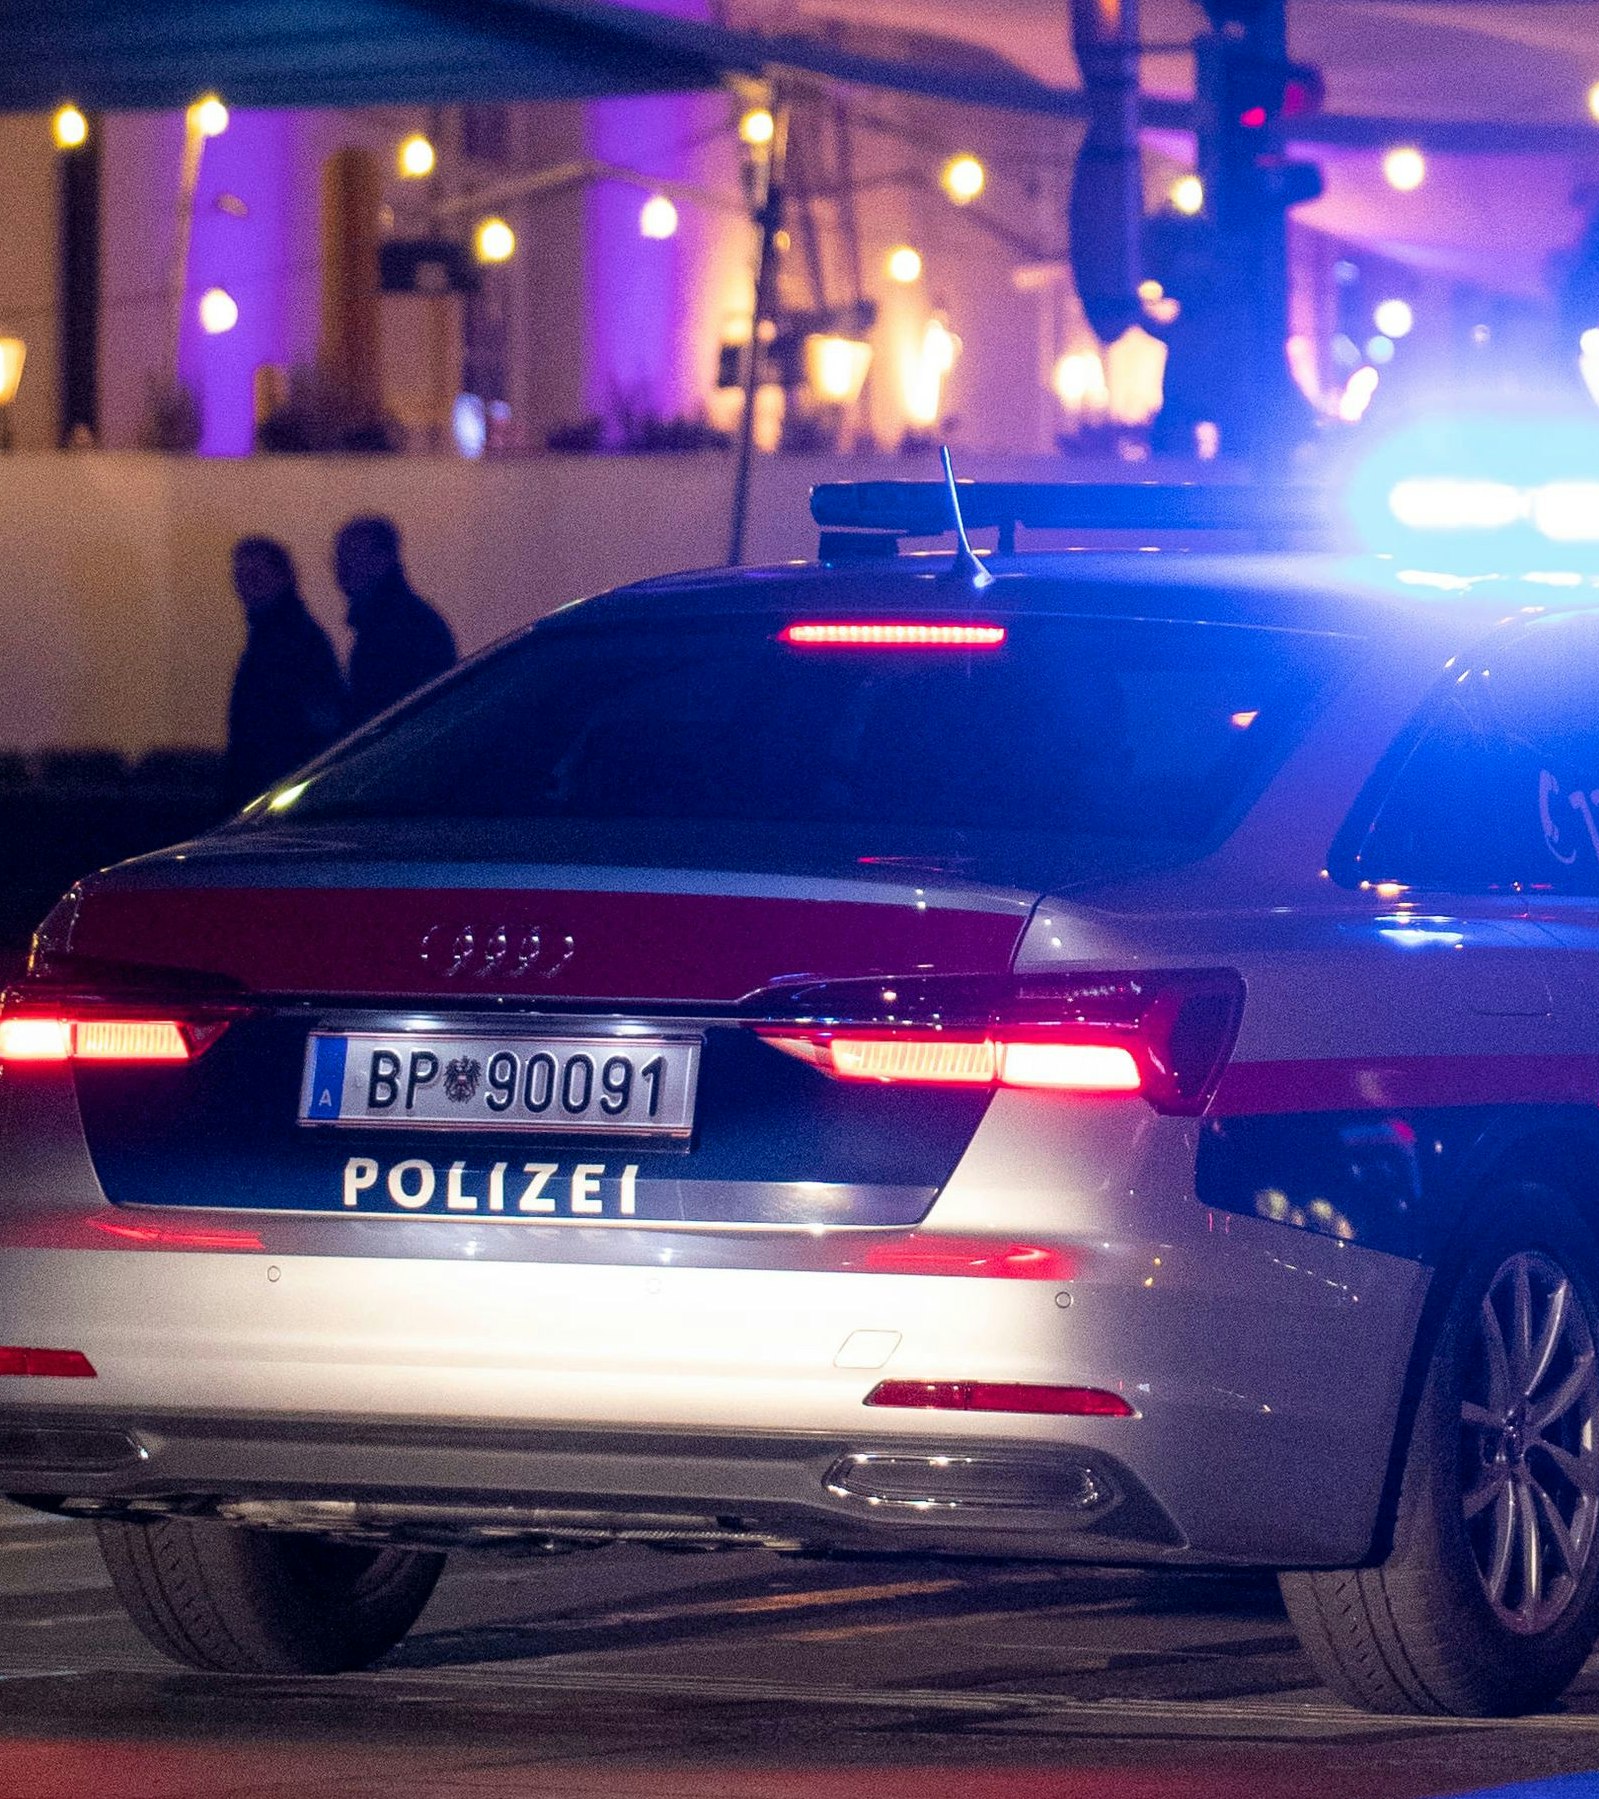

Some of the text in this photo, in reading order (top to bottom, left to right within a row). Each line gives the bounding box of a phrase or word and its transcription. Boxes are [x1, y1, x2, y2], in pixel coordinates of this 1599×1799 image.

[318, 1049, 665, 1118] A BP 90091
[343, 1157, 639, 1215] POLIZEI
